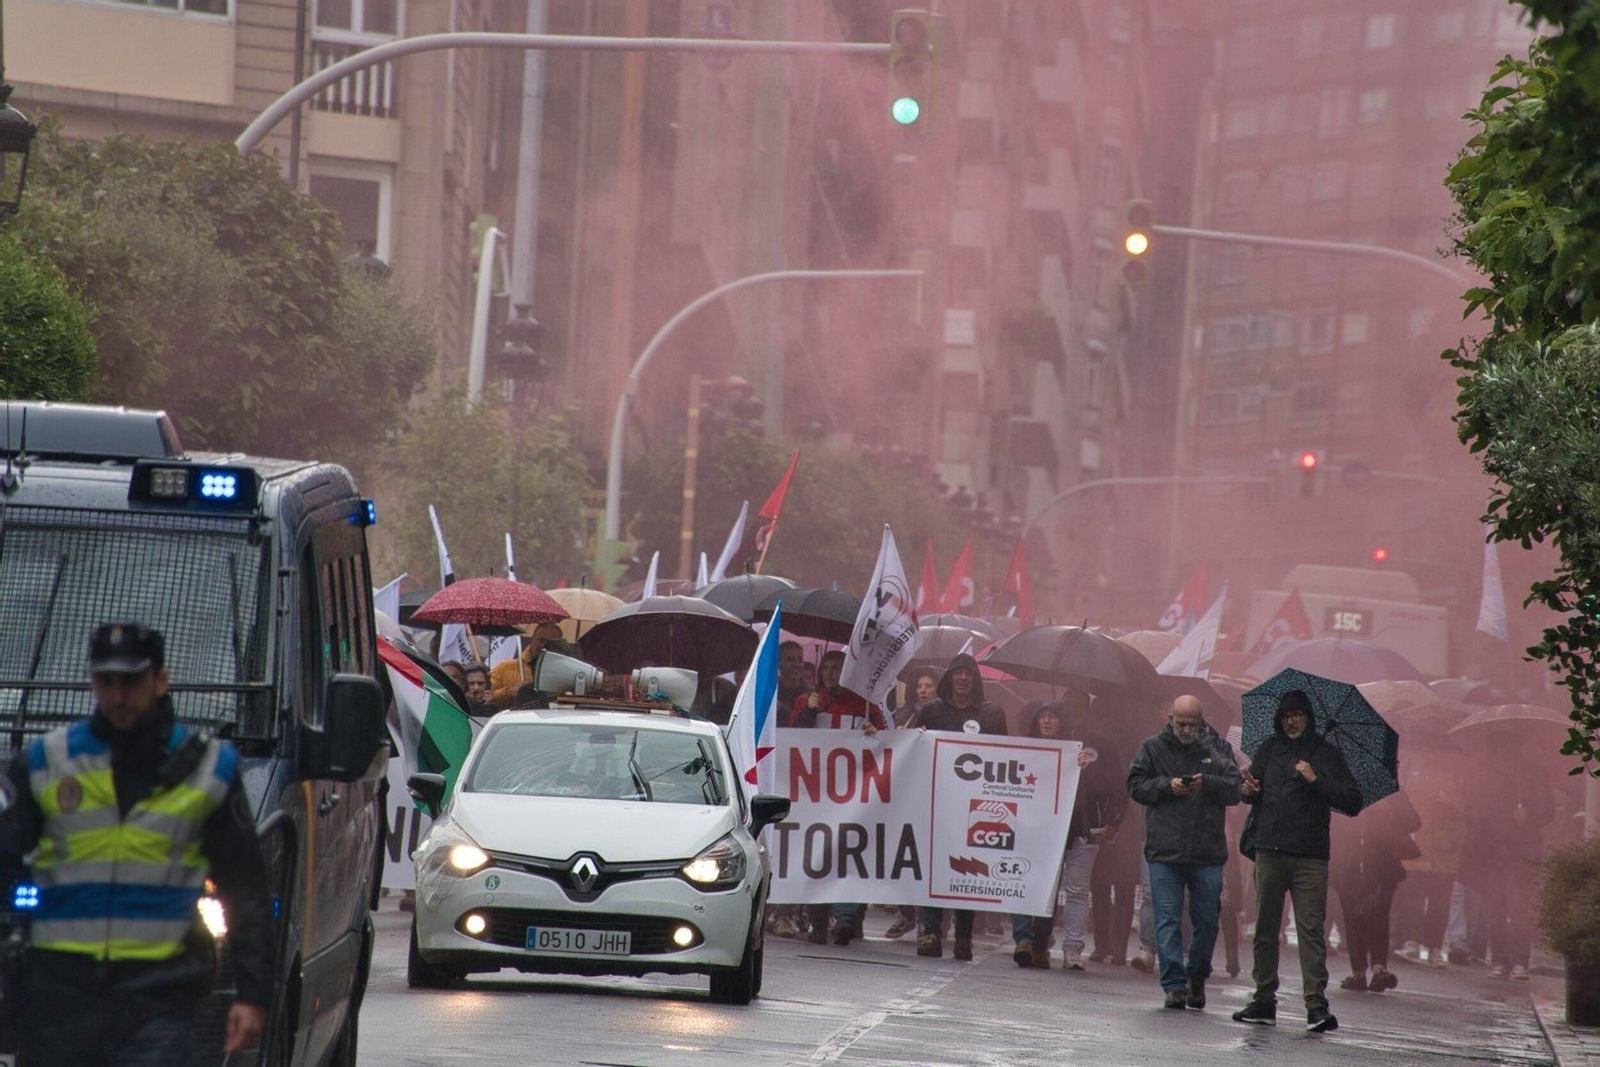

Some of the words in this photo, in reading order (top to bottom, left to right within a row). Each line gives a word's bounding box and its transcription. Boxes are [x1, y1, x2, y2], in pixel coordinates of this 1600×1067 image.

[1334, 611, 1362, 632] 15C
[789, 747, 893, 804] NON
[982, 783, 1008, 791] Central
[1008, 785, 1035, 793] Unitaria
[973, 830, 1011, 847] CGT
[773, 822, 922, 881] TORIA
[1000, 862, 1022, 875] S.F.
[949, 883, 1026, 899] INTERSINDICAL
[539, 930, 586, 950] 0510
[592, 932, 627, 952] JHH
